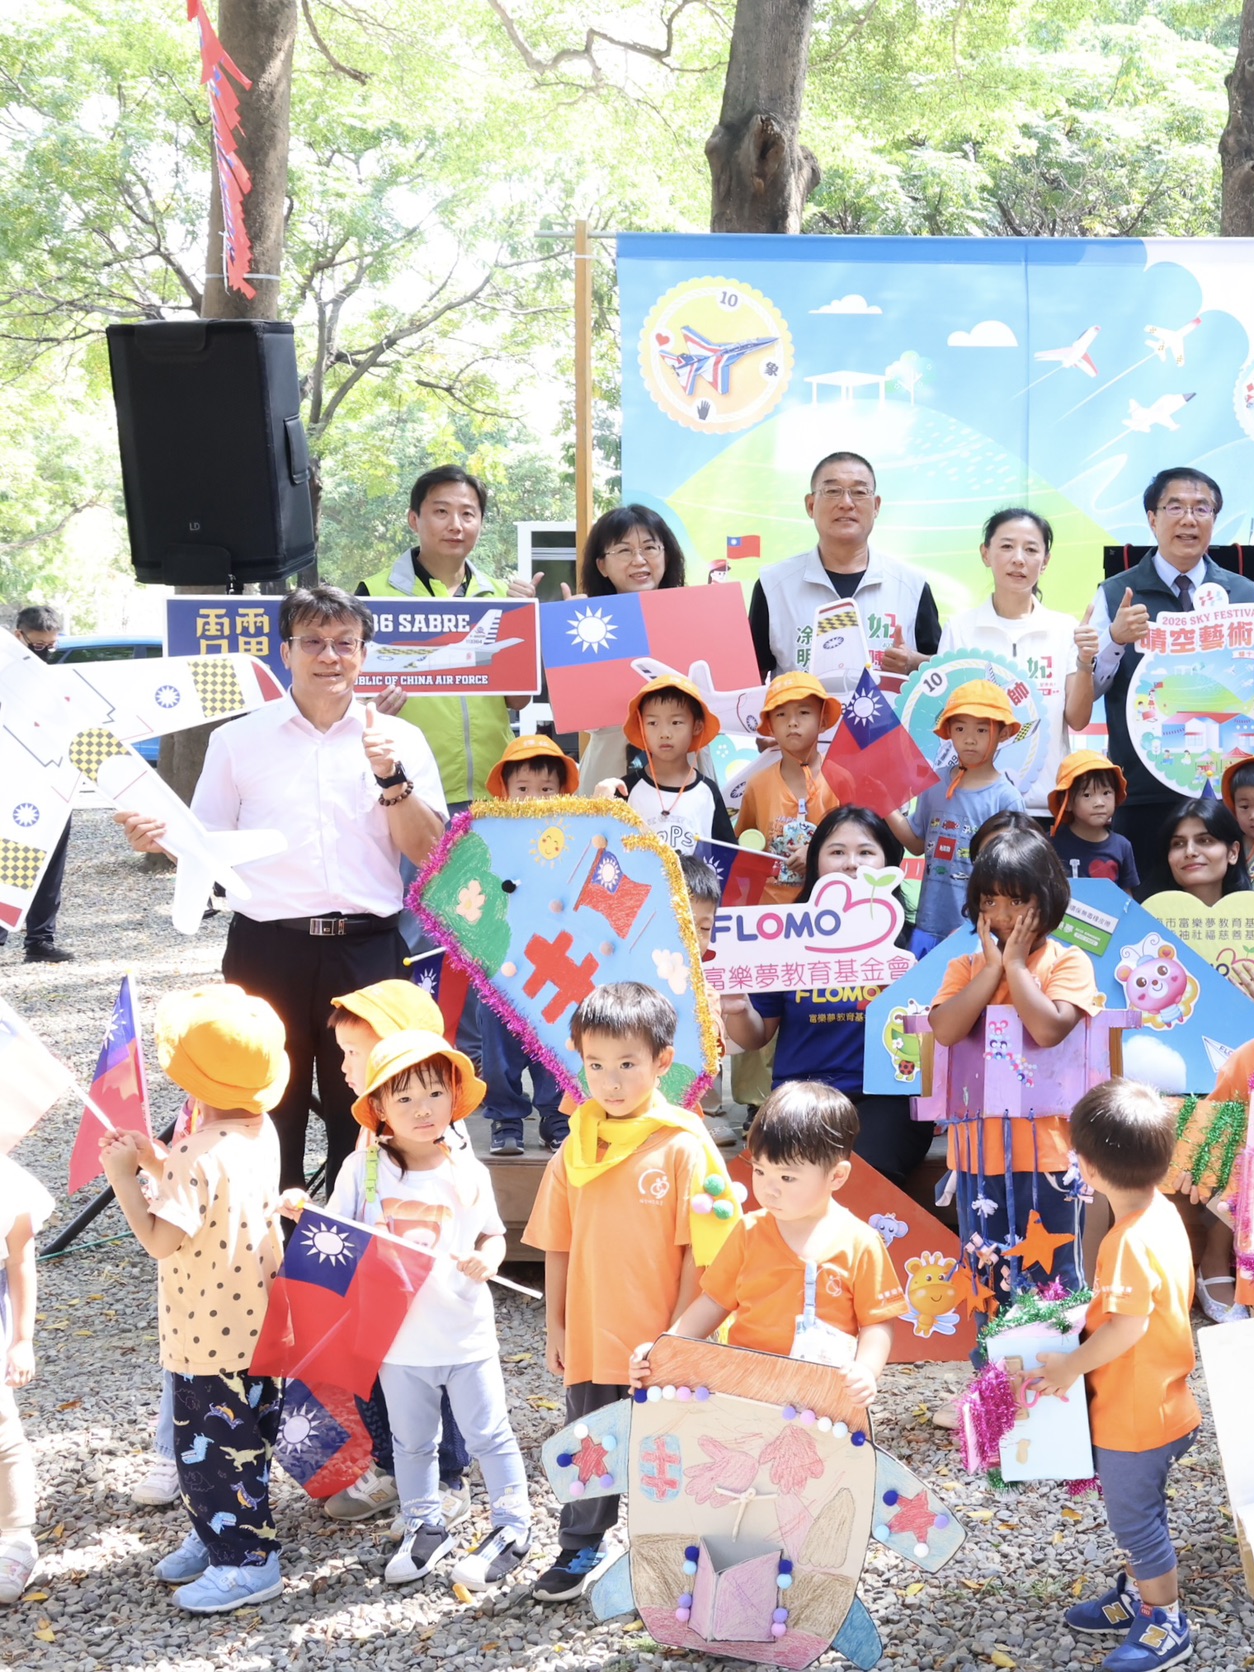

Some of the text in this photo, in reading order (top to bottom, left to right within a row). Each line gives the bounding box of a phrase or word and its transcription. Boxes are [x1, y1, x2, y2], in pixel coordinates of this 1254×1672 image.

[720, 291, 738, 307] 10
[764, 362, 779, 376] 象
[189, 522, 201, 531] LD
[372, 613, 471, 633] 86 SABRE
[1162, 616, 1187, 627] 2026
[1189, 613, 1211, 625] SKY
[797, 625, 813, 673] 涂明
[354, 675, 488, 685] BLIC OF CHINA AIR FORCE
[922, 672, 944, 693] 10
[1007, 680, 1029, 707] 帥
[710, 909, 841, 943] FLOMO
[703, 955, 911, 992] 富樂夢教育基金會
[796, 986, 881, 1004] FLOMO
[808, 1012, 866, 1024] 富樂夢教育基
